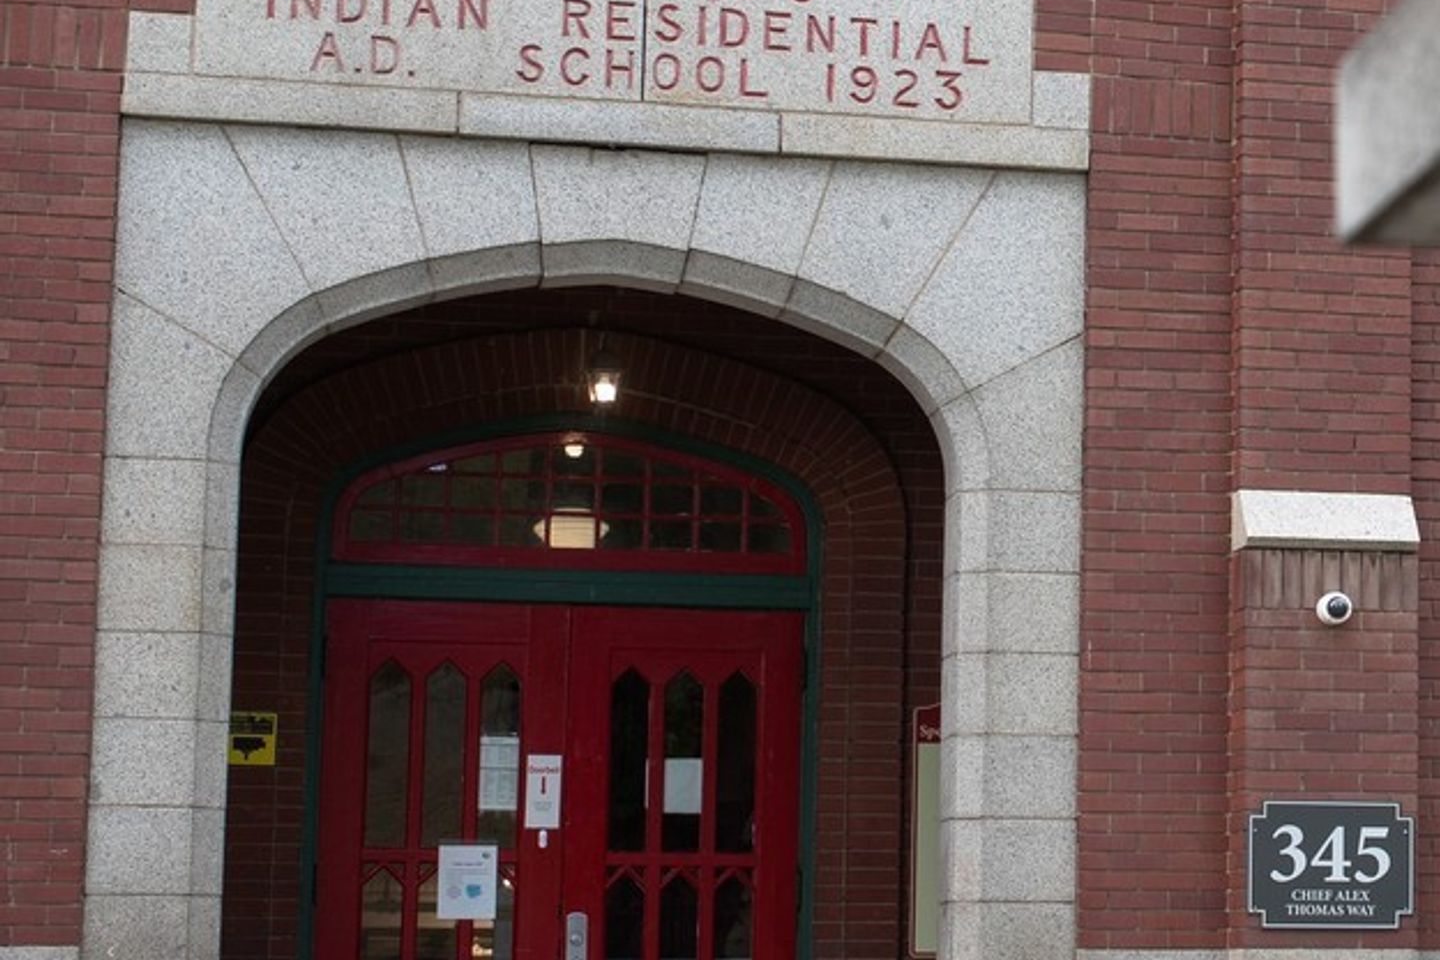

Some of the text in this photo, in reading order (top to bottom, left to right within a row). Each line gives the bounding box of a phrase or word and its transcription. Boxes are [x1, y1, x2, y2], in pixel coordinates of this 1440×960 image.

[309, 31, 964, 110] A.D. SCHOOL 1923
[1270, 824, 1391, 883] 345
[1285, 904, 1377, 916] THOMAS WAY
[1291, 889, 1370, 902] CHIEF ALEX
